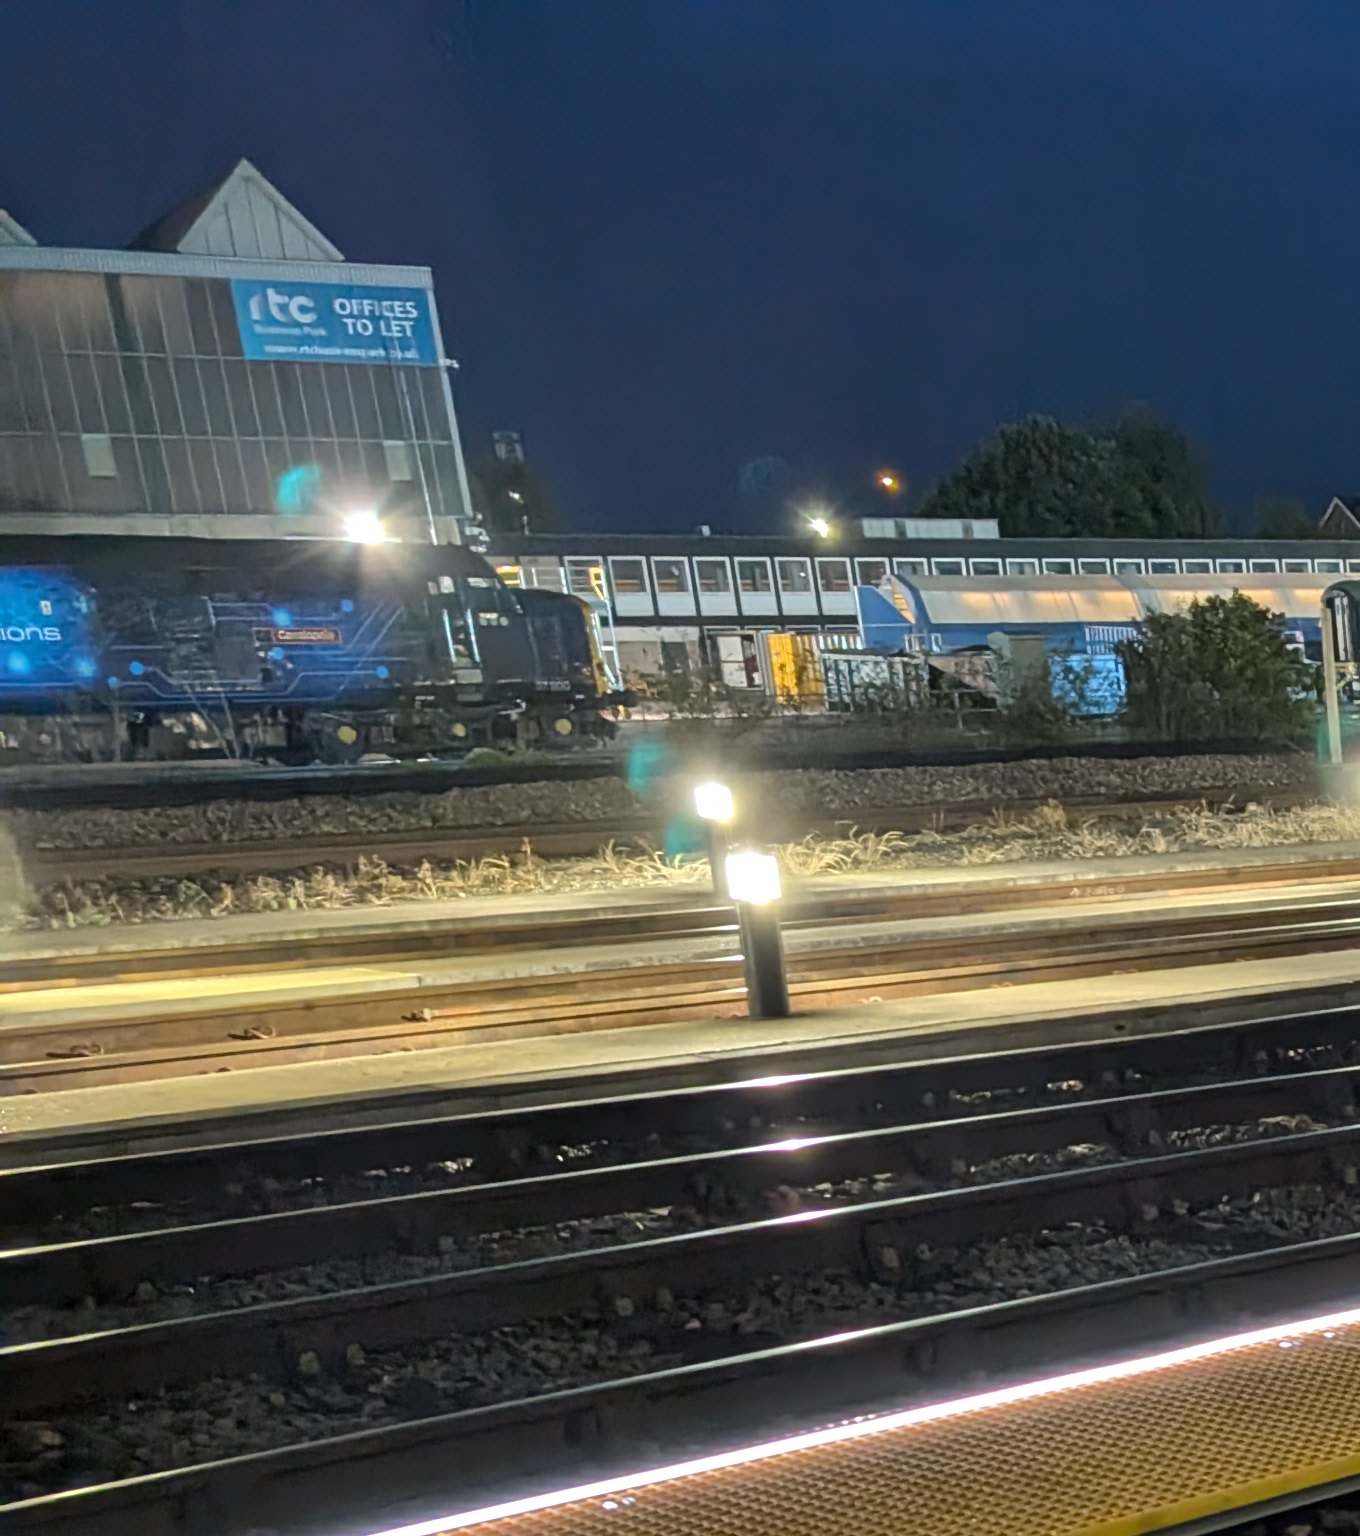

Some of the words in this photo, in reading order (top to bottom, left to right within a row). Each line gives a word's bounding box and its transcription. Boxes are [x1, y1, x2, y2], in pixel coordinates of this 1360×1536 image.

[250, 287, 318, 323] rtc
[333, 298, 418, 318] OFFICES
[342, 318, 373, 336] TO
[380, 319, 415, 337] LET
